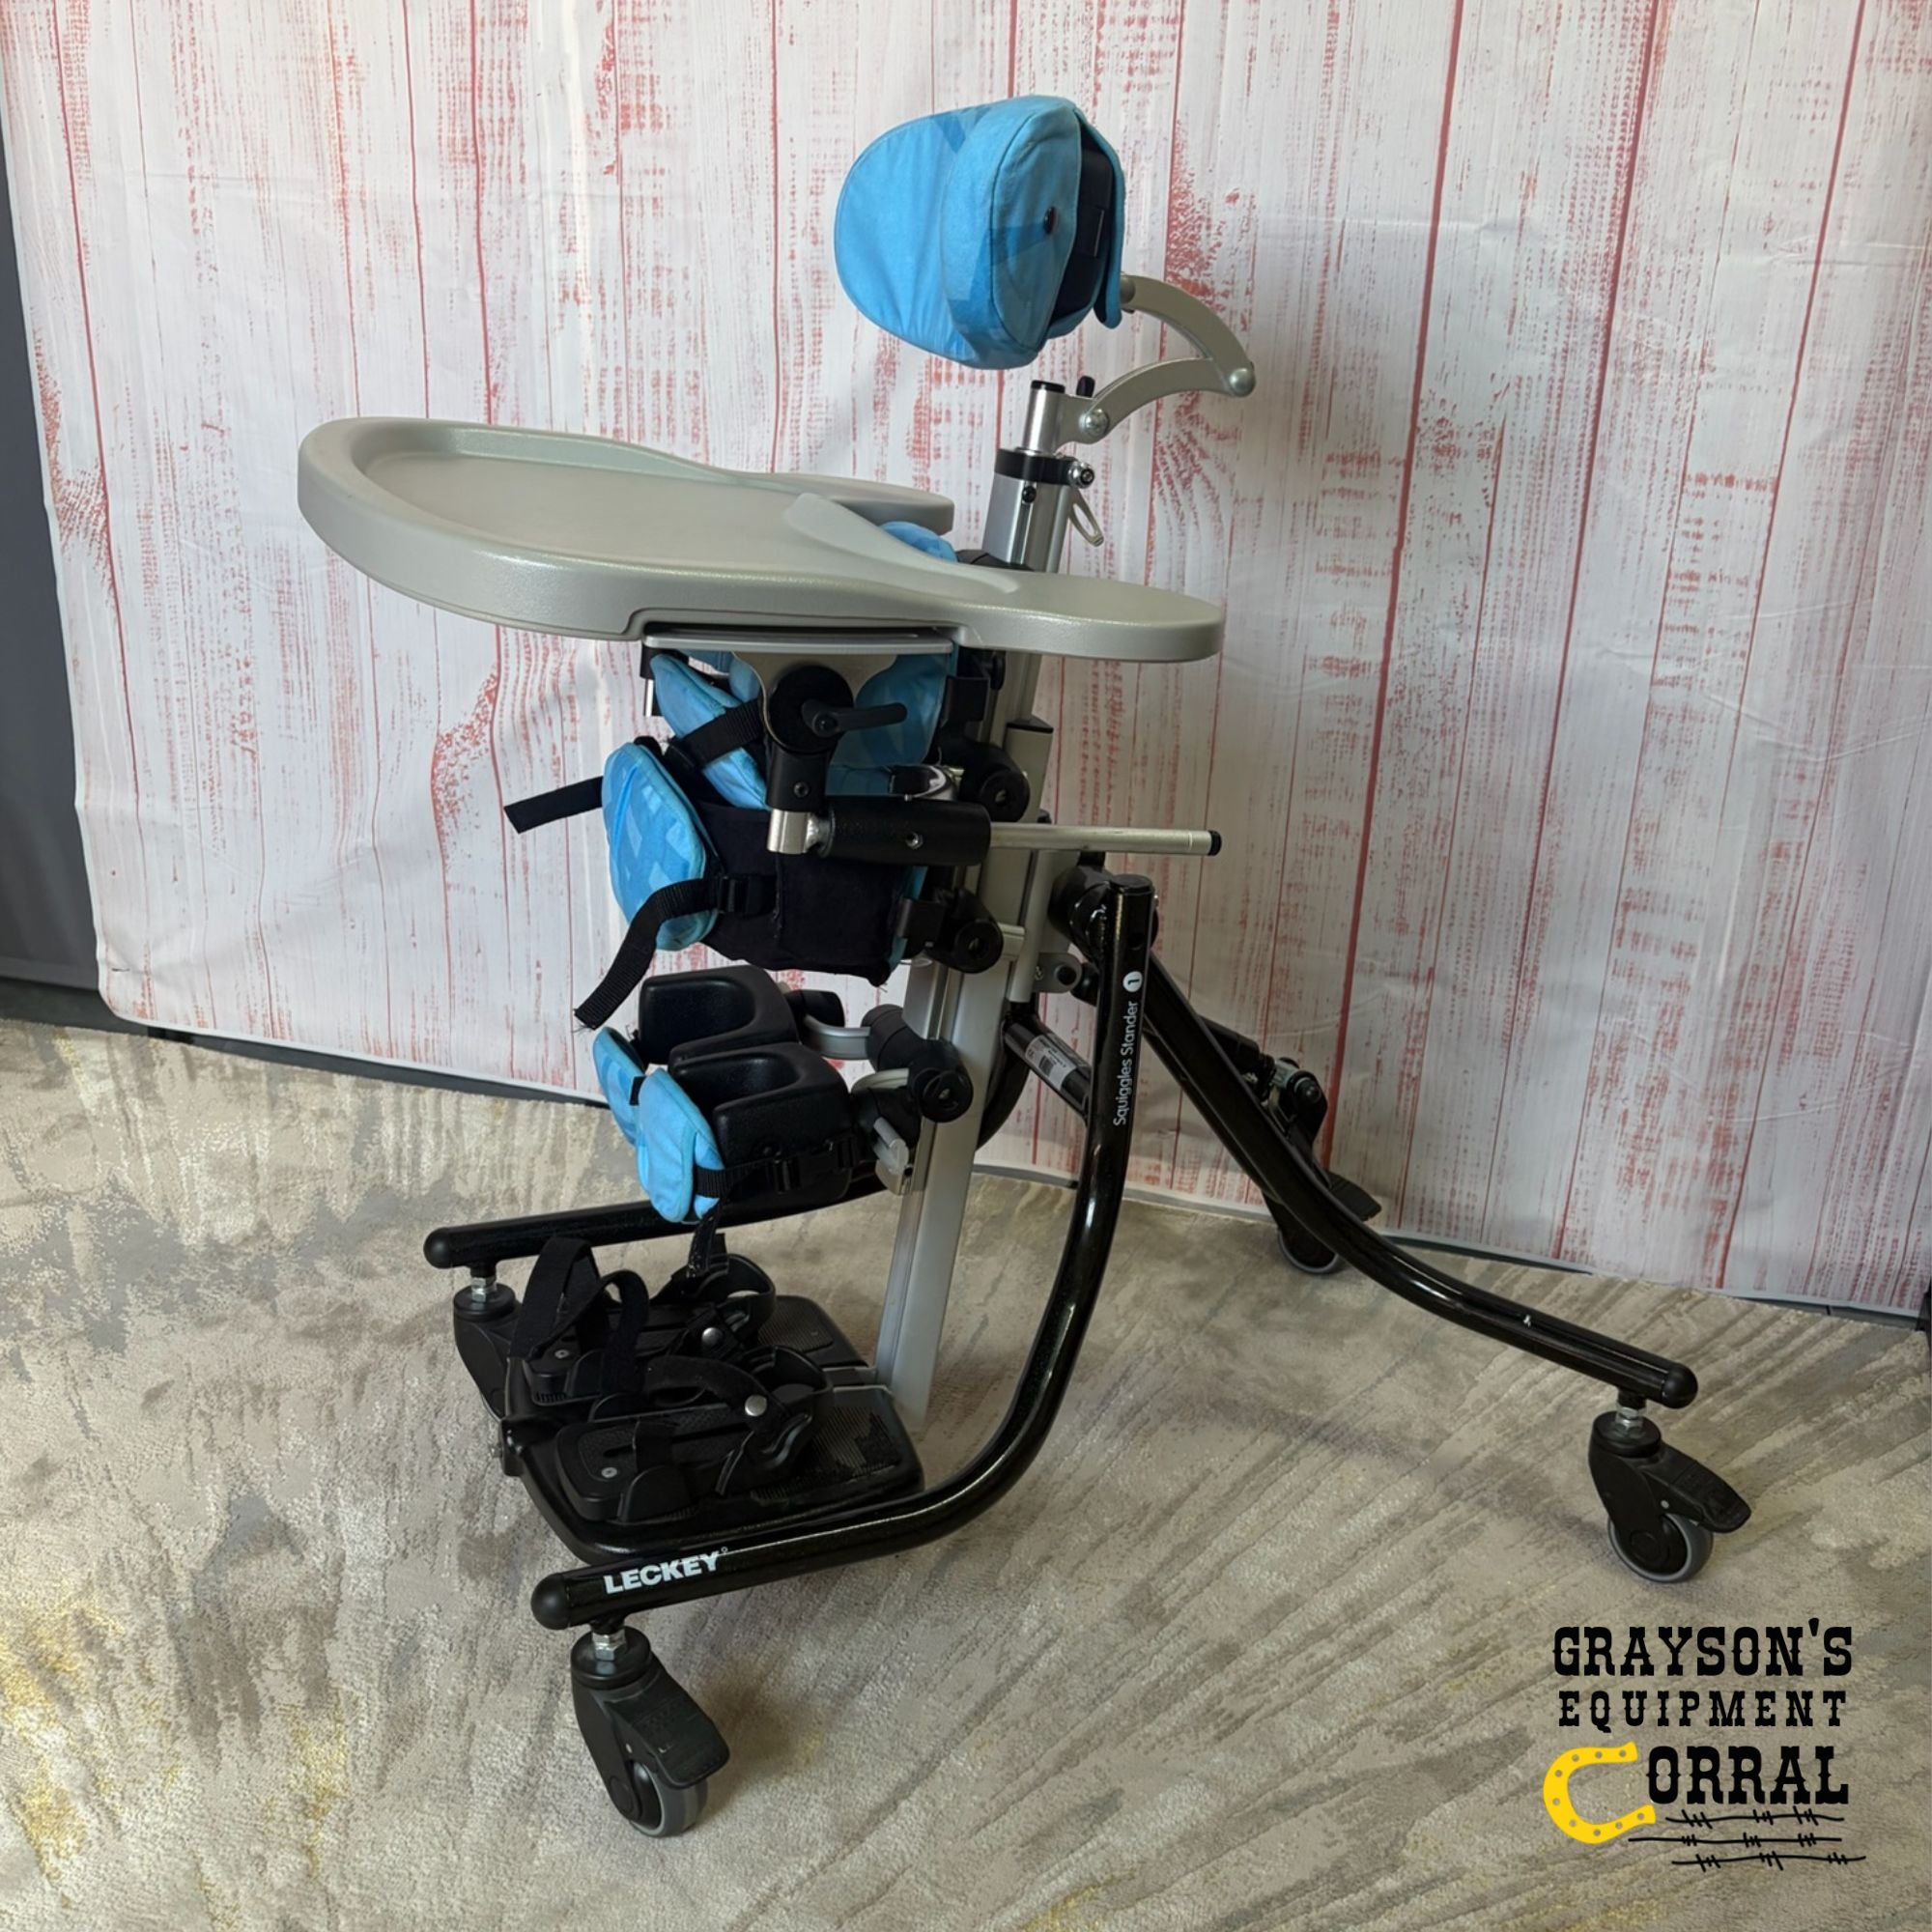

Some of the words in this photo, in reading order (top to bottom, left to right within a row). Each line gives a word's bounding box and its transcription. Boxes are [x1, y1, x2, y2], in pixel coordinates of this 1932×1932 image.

[1121, 1001, 1140, 1056] Stander
[1113, 1058, 1133, 1126] Squiggles
[603, 1550, 720, 1594] LECKEY
